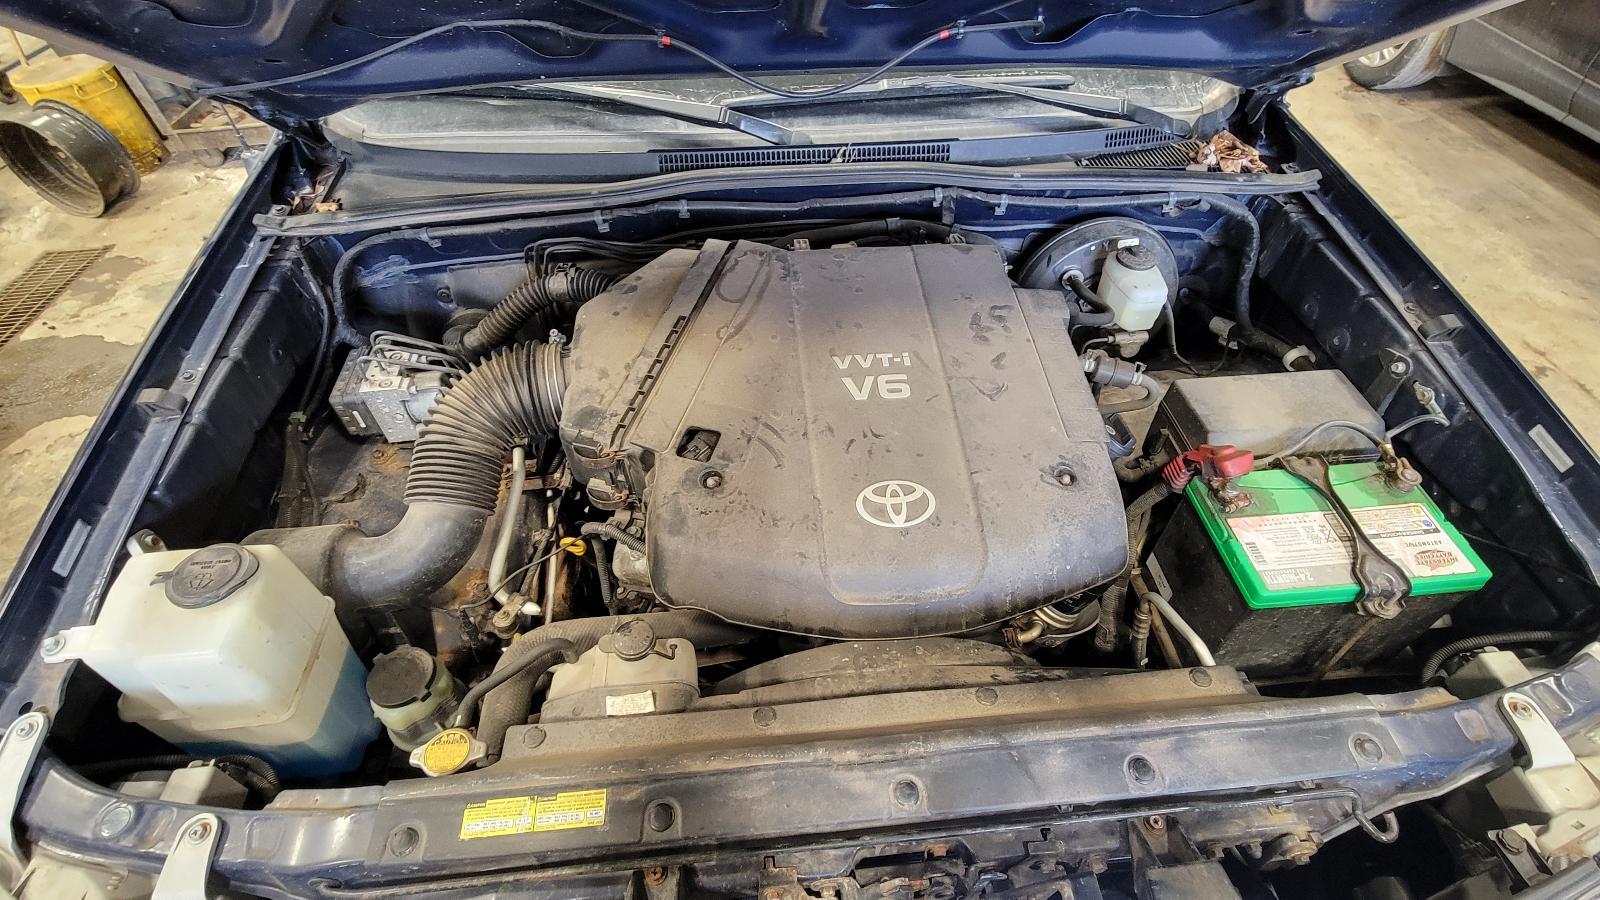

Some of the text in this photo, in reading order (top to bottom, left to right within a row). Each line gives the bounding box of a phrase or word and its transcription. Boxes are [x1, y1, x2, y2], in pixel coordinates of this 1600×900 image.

[831, 352, 912, 369] VVT-i
[840, 374, 911, 401] V6
[1416, 551, 1453, 560] BATTERIES
